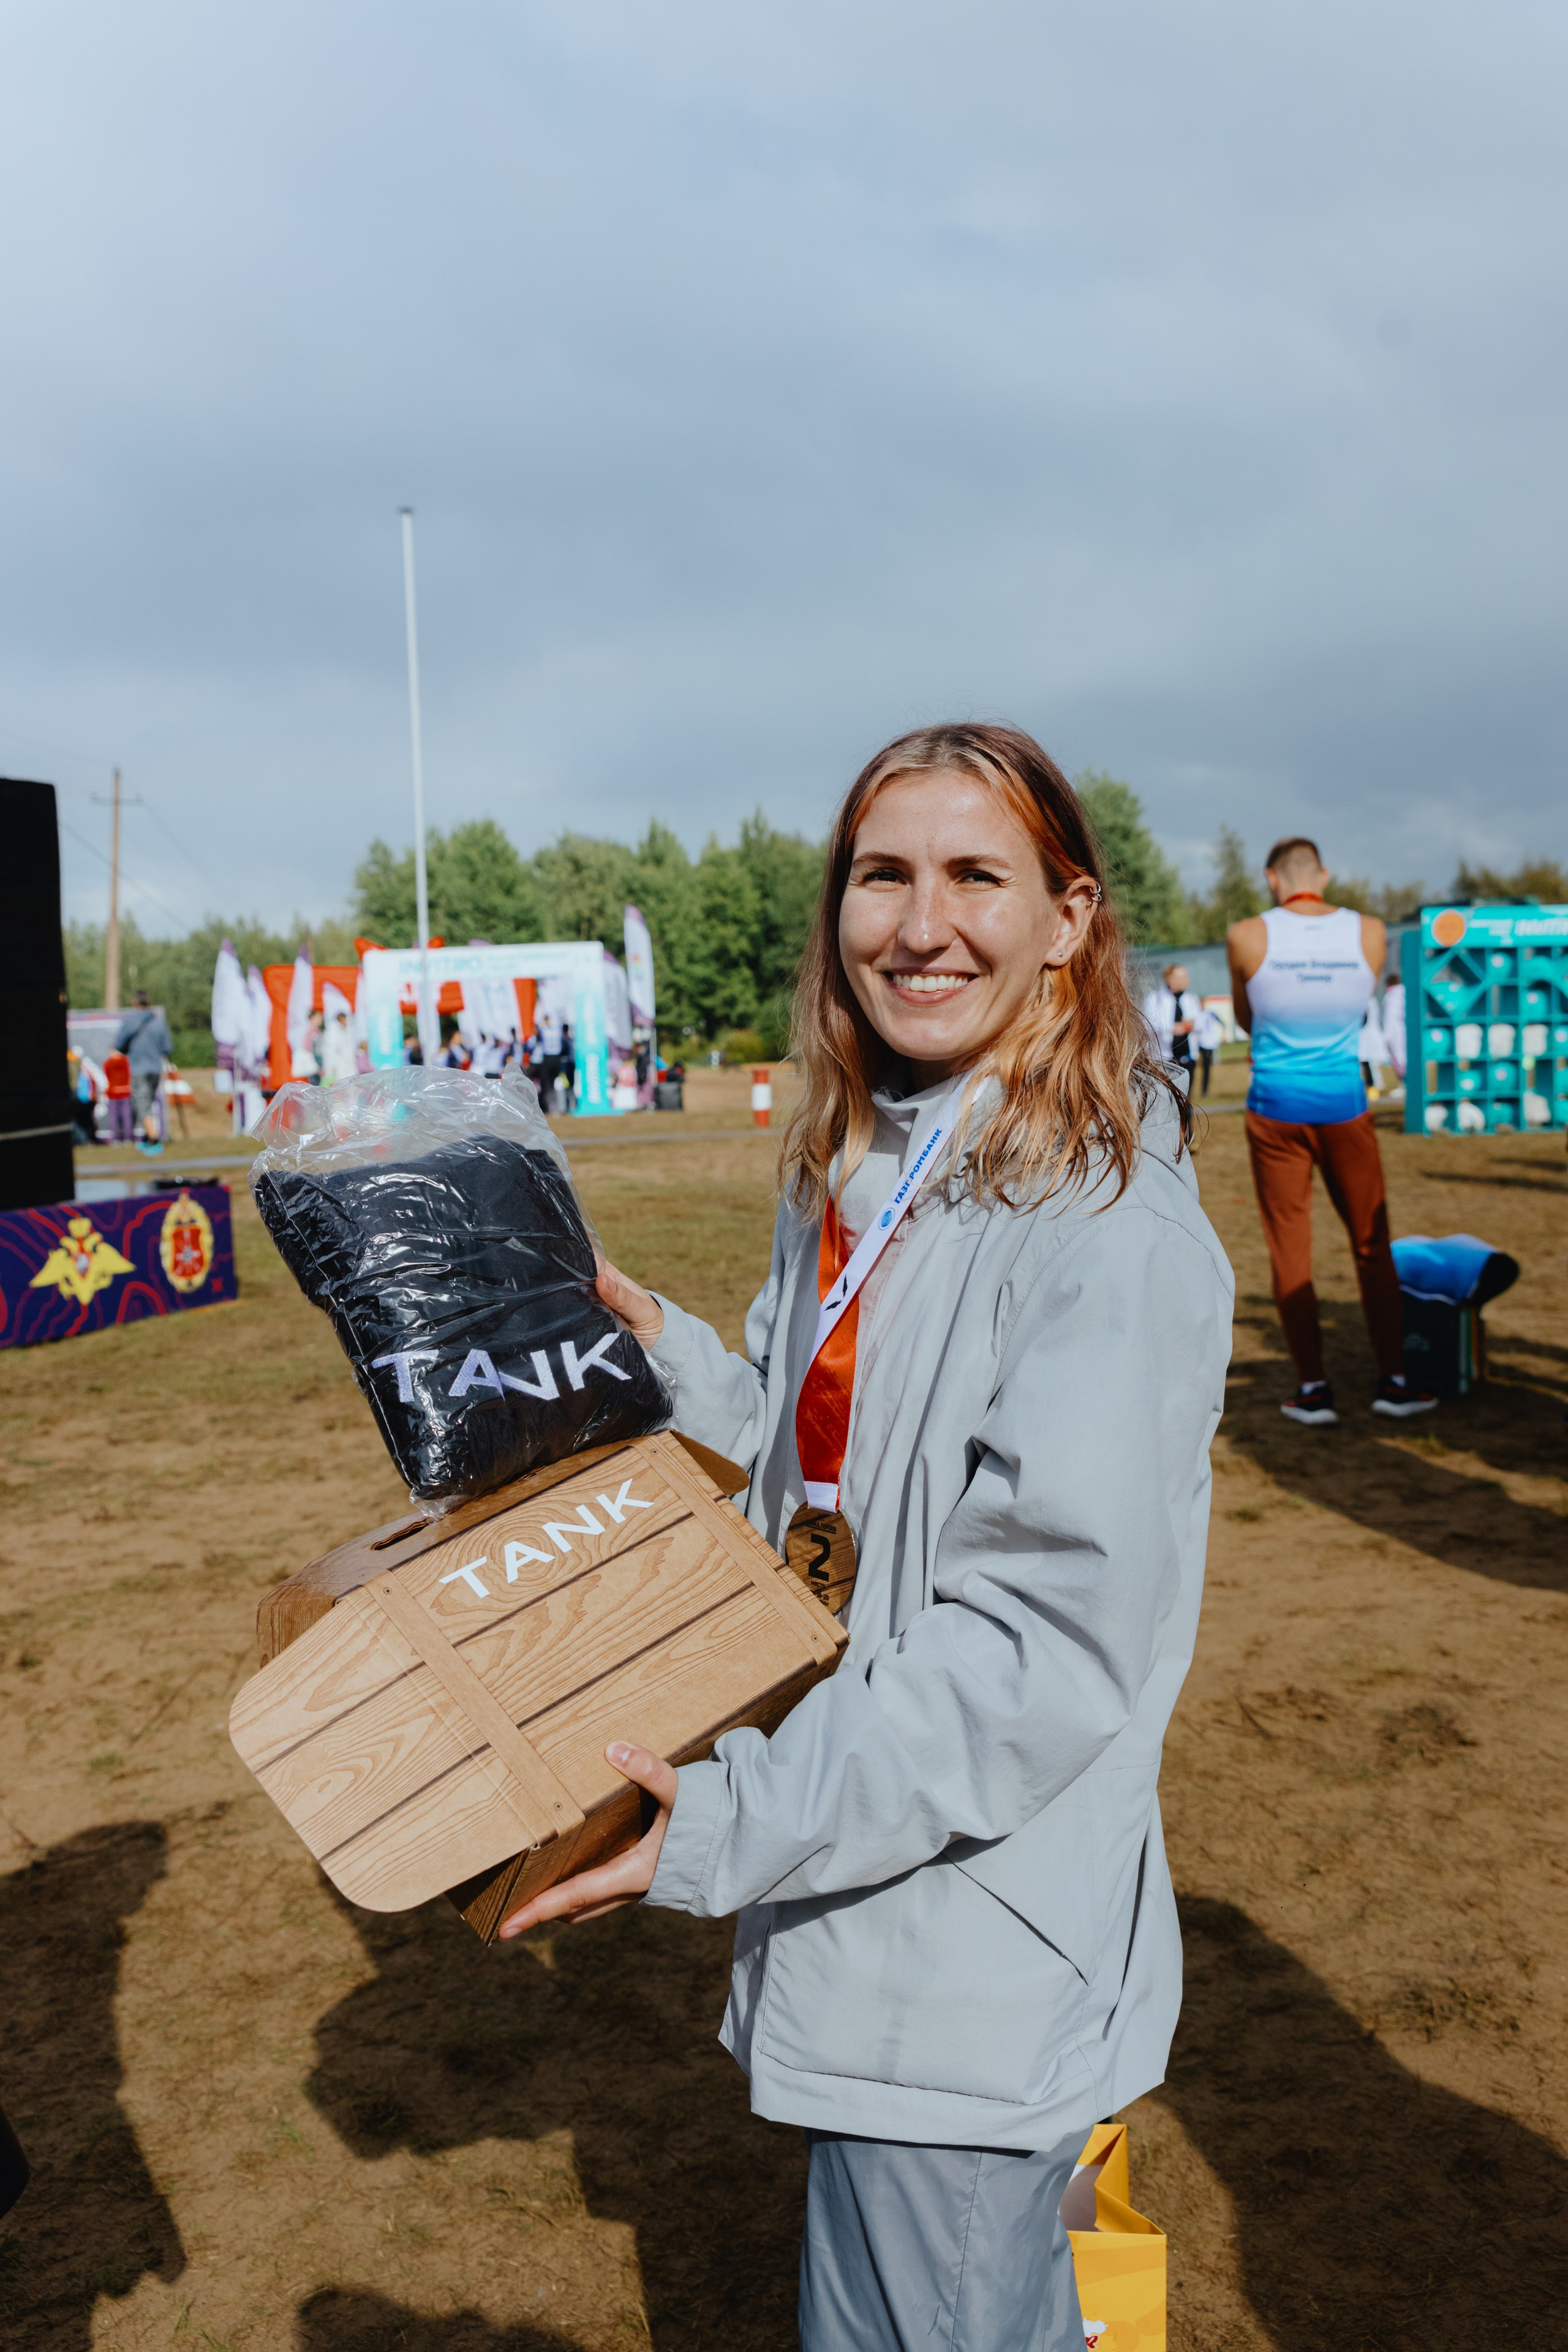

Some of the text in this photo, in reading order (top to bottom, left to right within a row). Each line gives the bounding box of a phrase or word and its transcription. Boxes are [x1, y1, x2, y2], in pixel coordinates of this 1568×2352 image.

[894, 1128, 942, 1204] ГАЗПРОМБАНК
[371, 1332, 632, 1403] TANK
[439, 1478, 655, 1599] TANK
[809, 1533, 831, 1582] 2
[821, 1523, 837, 1532] ГЕРОЕВ
